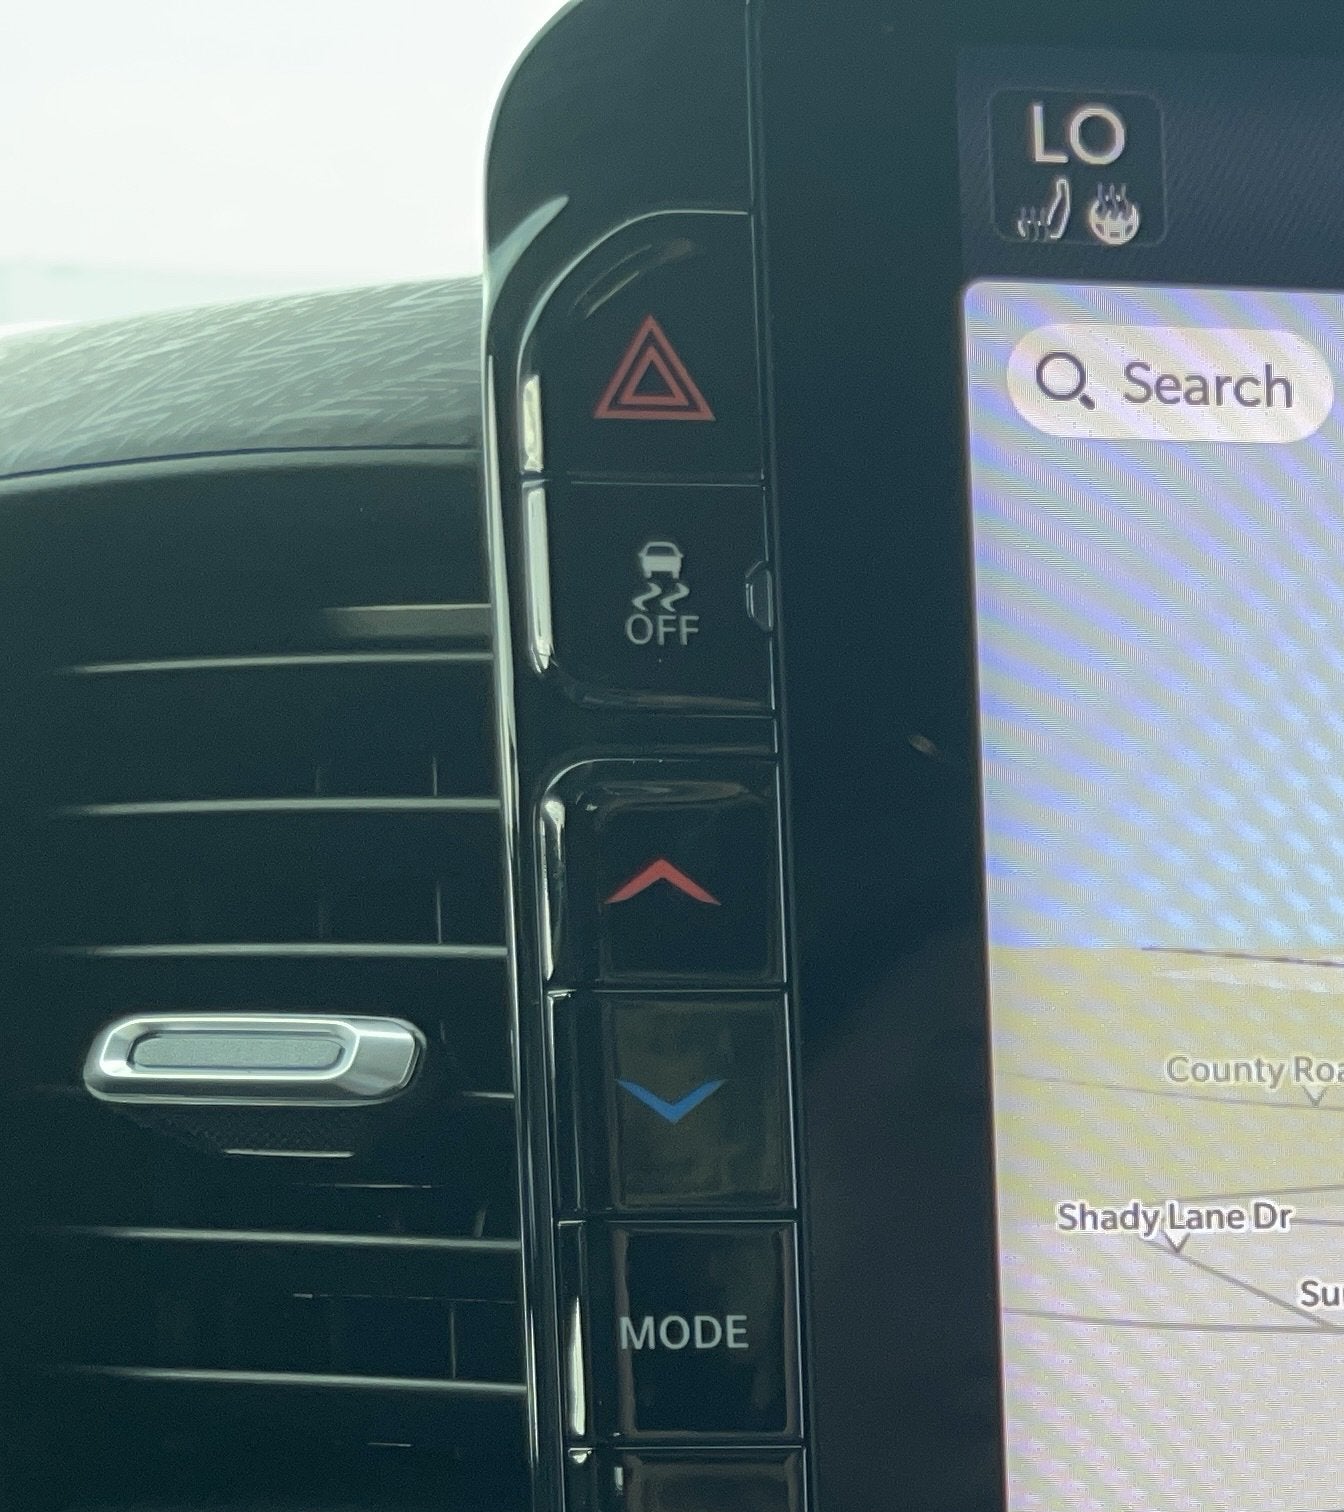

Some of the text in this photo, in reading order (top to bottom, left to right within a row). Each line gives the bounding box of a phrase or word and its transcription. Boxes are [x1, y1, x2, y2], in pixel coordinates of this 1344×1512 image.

[1031, 103, 1126, 166] LO
[1122, 361, 1294, 410] Search
[625, 614, 700, 646] OFF
[1165, 1055, 1285, 1089] County
[1058, 1202, 1293, 1238] Shady Lane Dr
[619, 1314, 750, 1350] MODE
